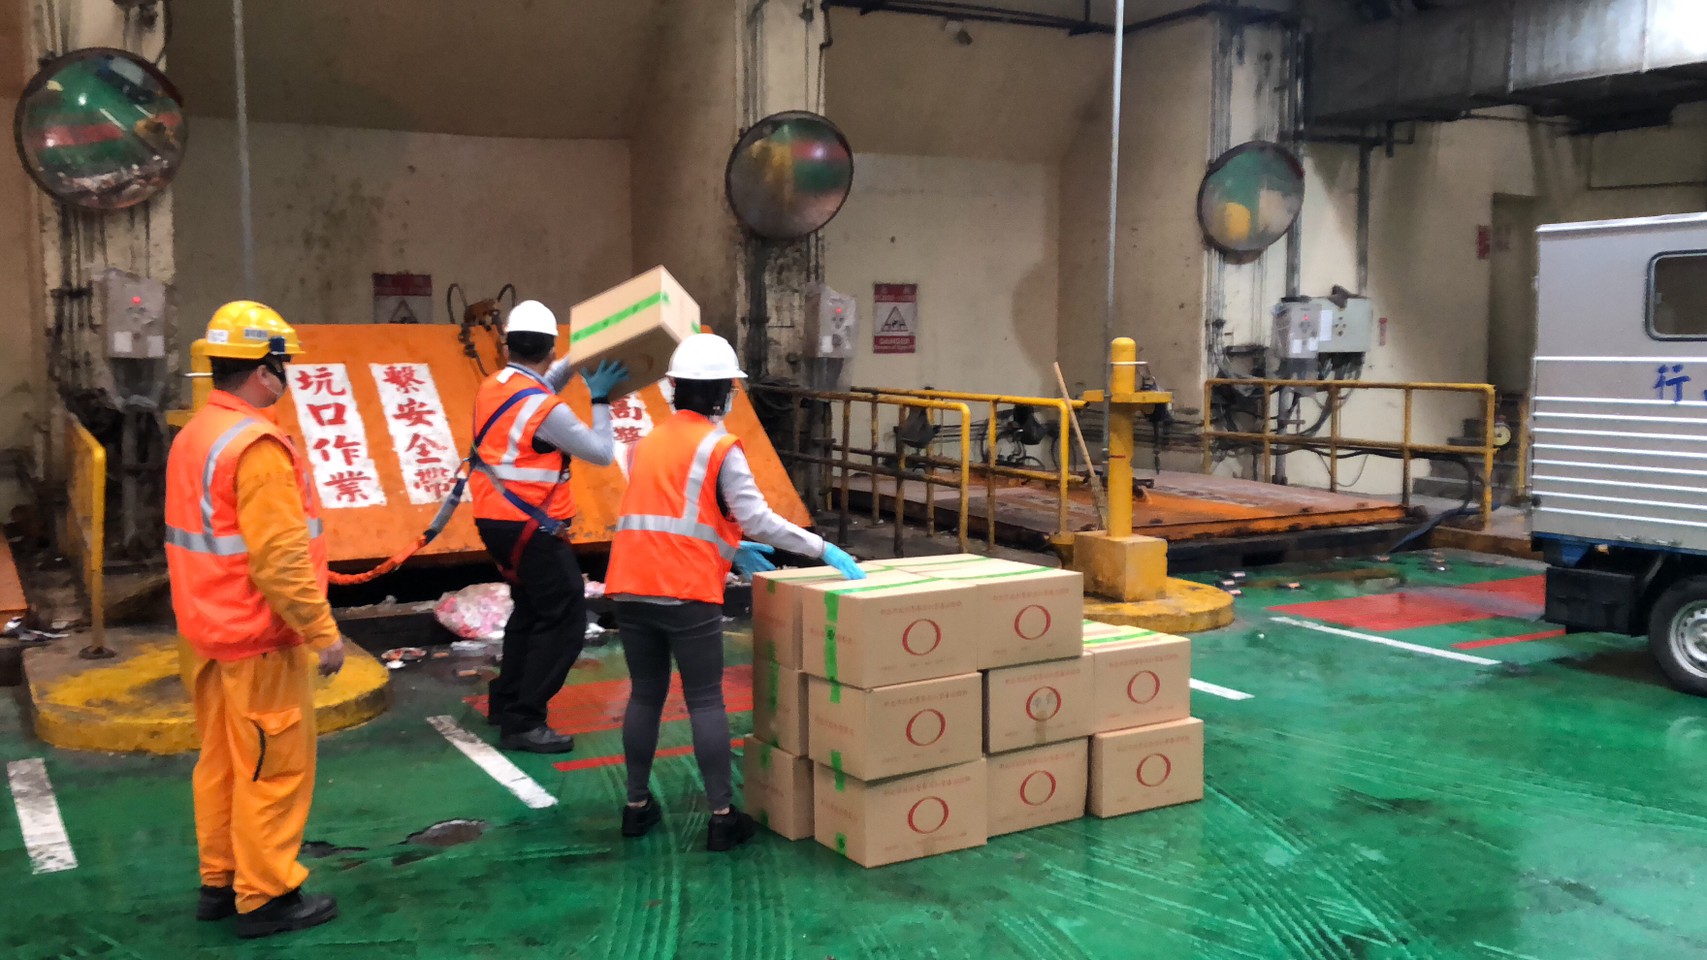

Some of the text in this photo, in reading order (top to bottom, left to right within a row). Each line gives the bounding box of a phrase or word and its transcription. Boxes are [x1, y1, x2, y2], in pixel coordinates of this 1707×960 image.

[1653, 364, 1707, 405] 行
[295, 366, 372, 502] 坑口作業
